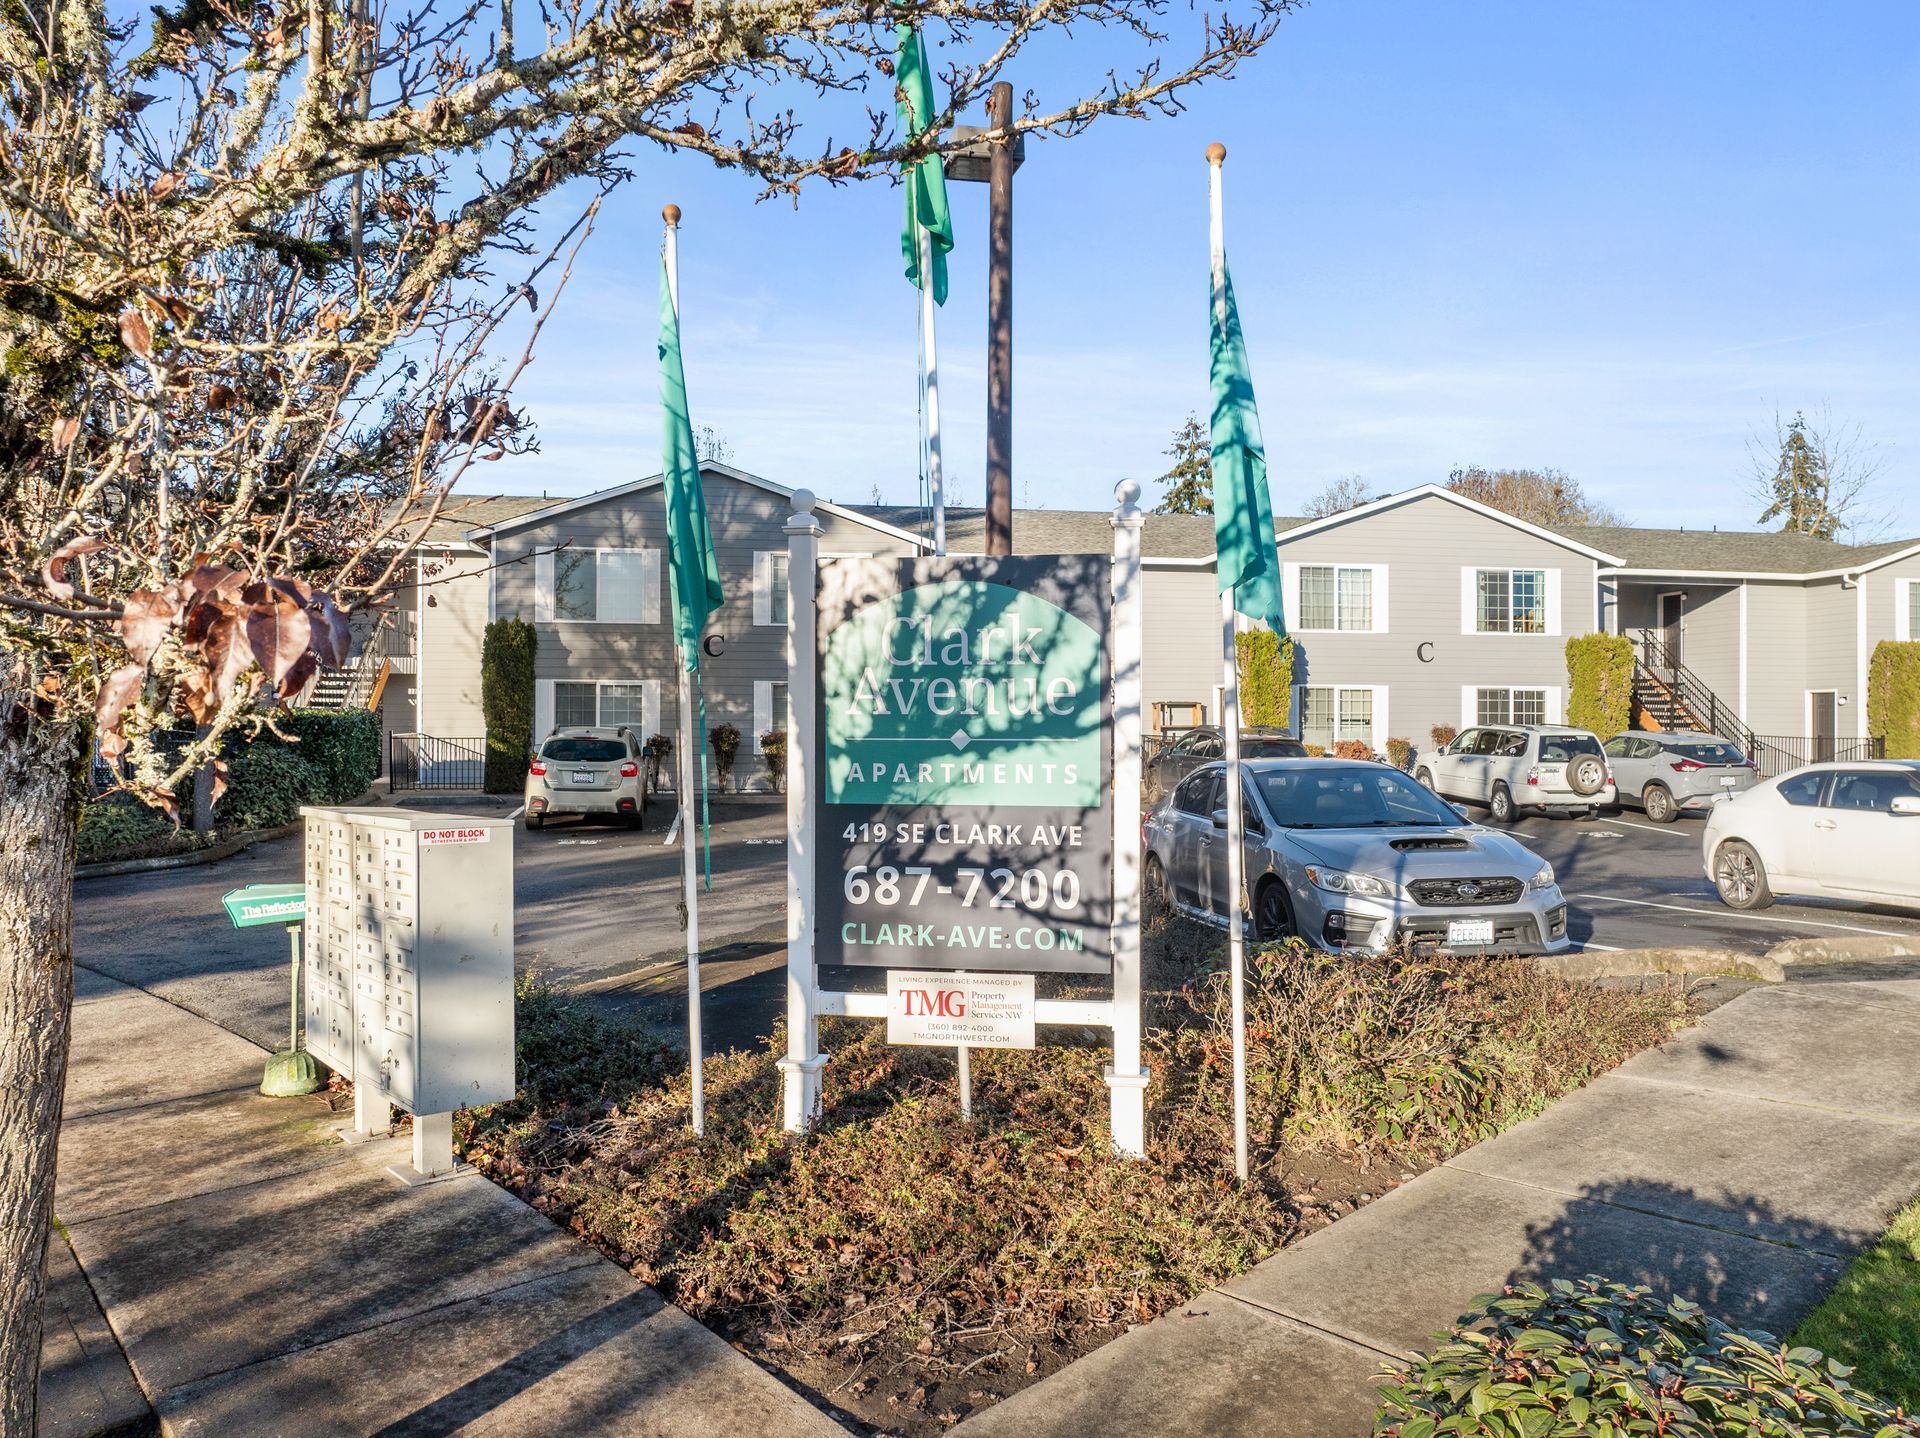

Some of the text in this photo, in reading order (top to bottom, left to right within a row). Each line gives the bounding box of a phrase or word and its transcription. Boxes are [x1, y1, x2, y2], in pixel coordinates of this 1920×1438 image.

[703, 634, 725, 657] C
[881, 613, 1045, 667] Clark
[1416, 641, 1435, 663] C
[845, 666, 1077, 716] Avenue
[847, 762, 1078, 785] APARTMENTS
[423, 829, 485, 839] DO NOT BLOCK
[842, 822, 1082, 846] 419 SE CLARK AVE
[843, 865, 1081, 910] 687-7200
[241, 906, 261, 916] The
[841, 922, 1083, 951] CLARK-AVE.COM
[898, 976, 923, 984] LIVING
[925, 977, 971, 985] EXPERIENCE
[899, 989, 966, 1018] TMG
[971, 991, 1006, 1002] Property
[971, 1001, 1022, 1012] Management
[971, 1010, 1023, 1019] Services NW
[912, 1032, 1010, 1043] TMGNORTHWEST.COM
[927, 1023, 994, 1032] (360) 892-4000
